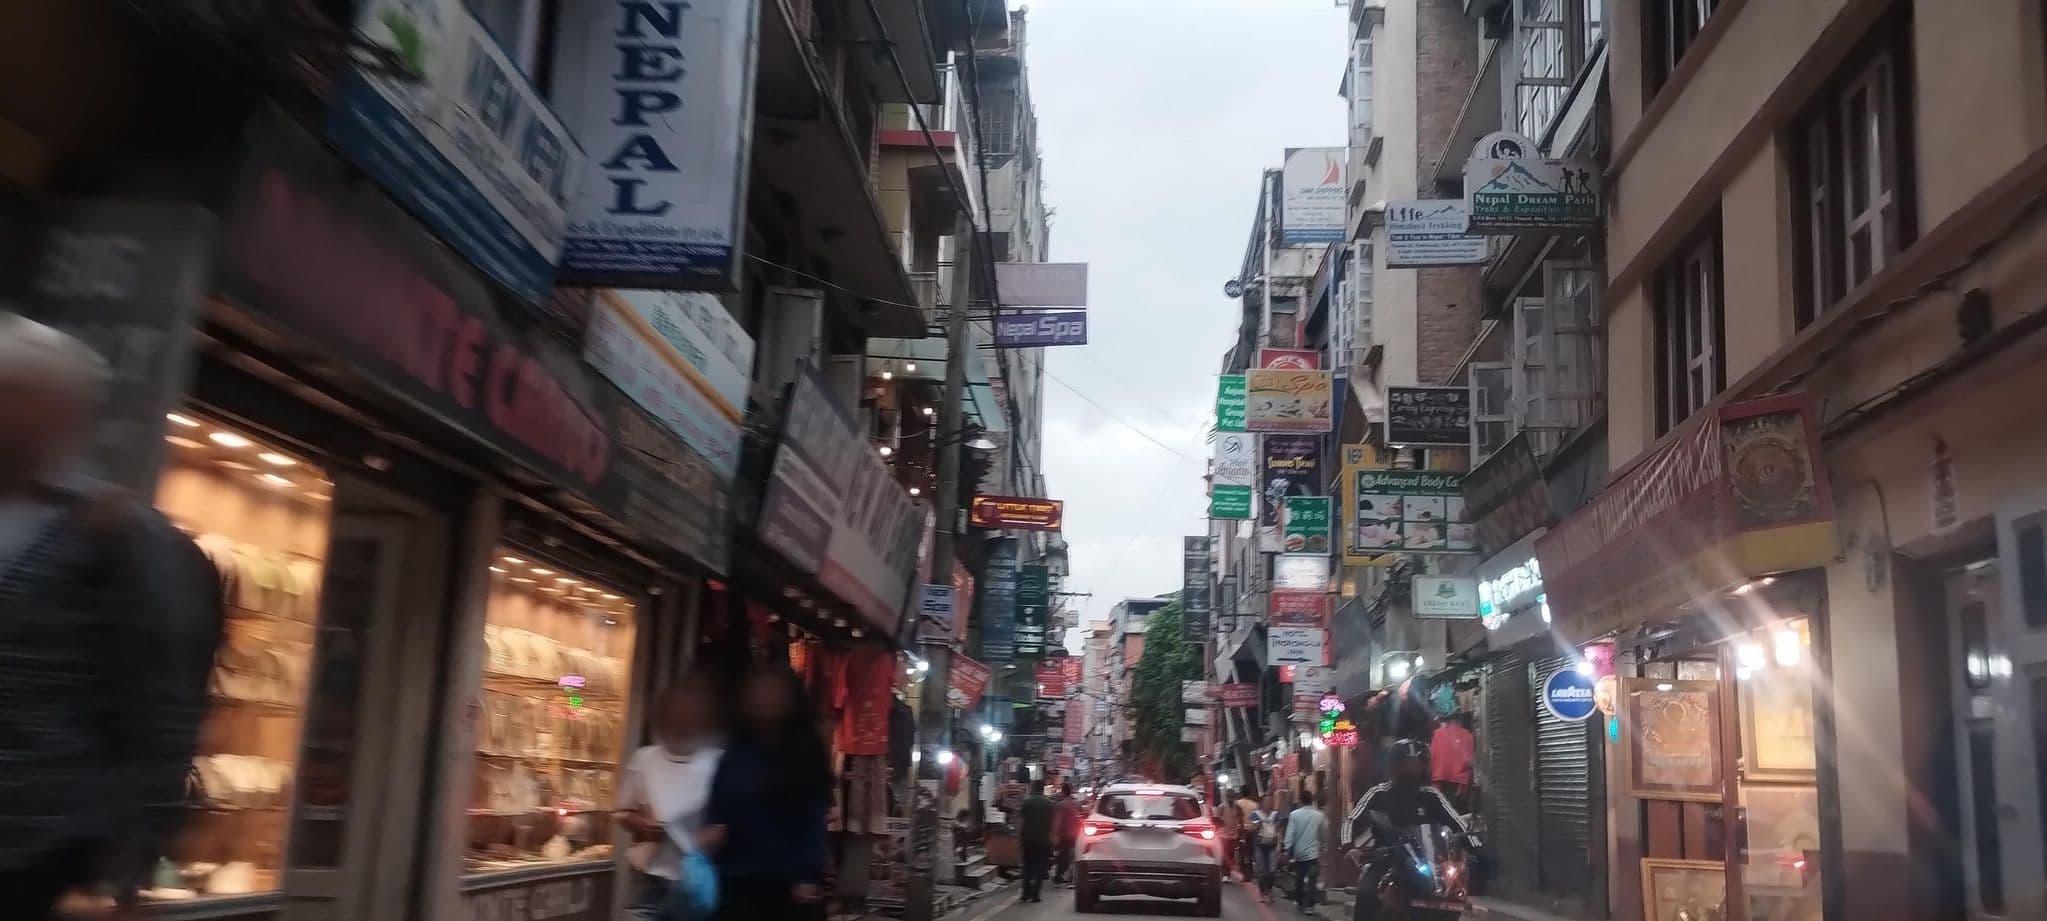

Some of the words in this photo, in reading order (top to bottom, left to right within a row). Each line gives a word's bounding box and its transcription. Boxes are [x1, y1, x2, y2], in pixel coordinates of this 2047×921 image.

[1429, 222, 1463, 231] Trekking
[996, 321, 1037, 342] Nepal
[1038, 316, 1084, 341] Spa
[1288, 375, 1328, 396] Spa
[1375, 474, 1417, 487] Advanced
[1420, 474, 1444, 489] Body
[1445, 476, 1460, 488] Ca
